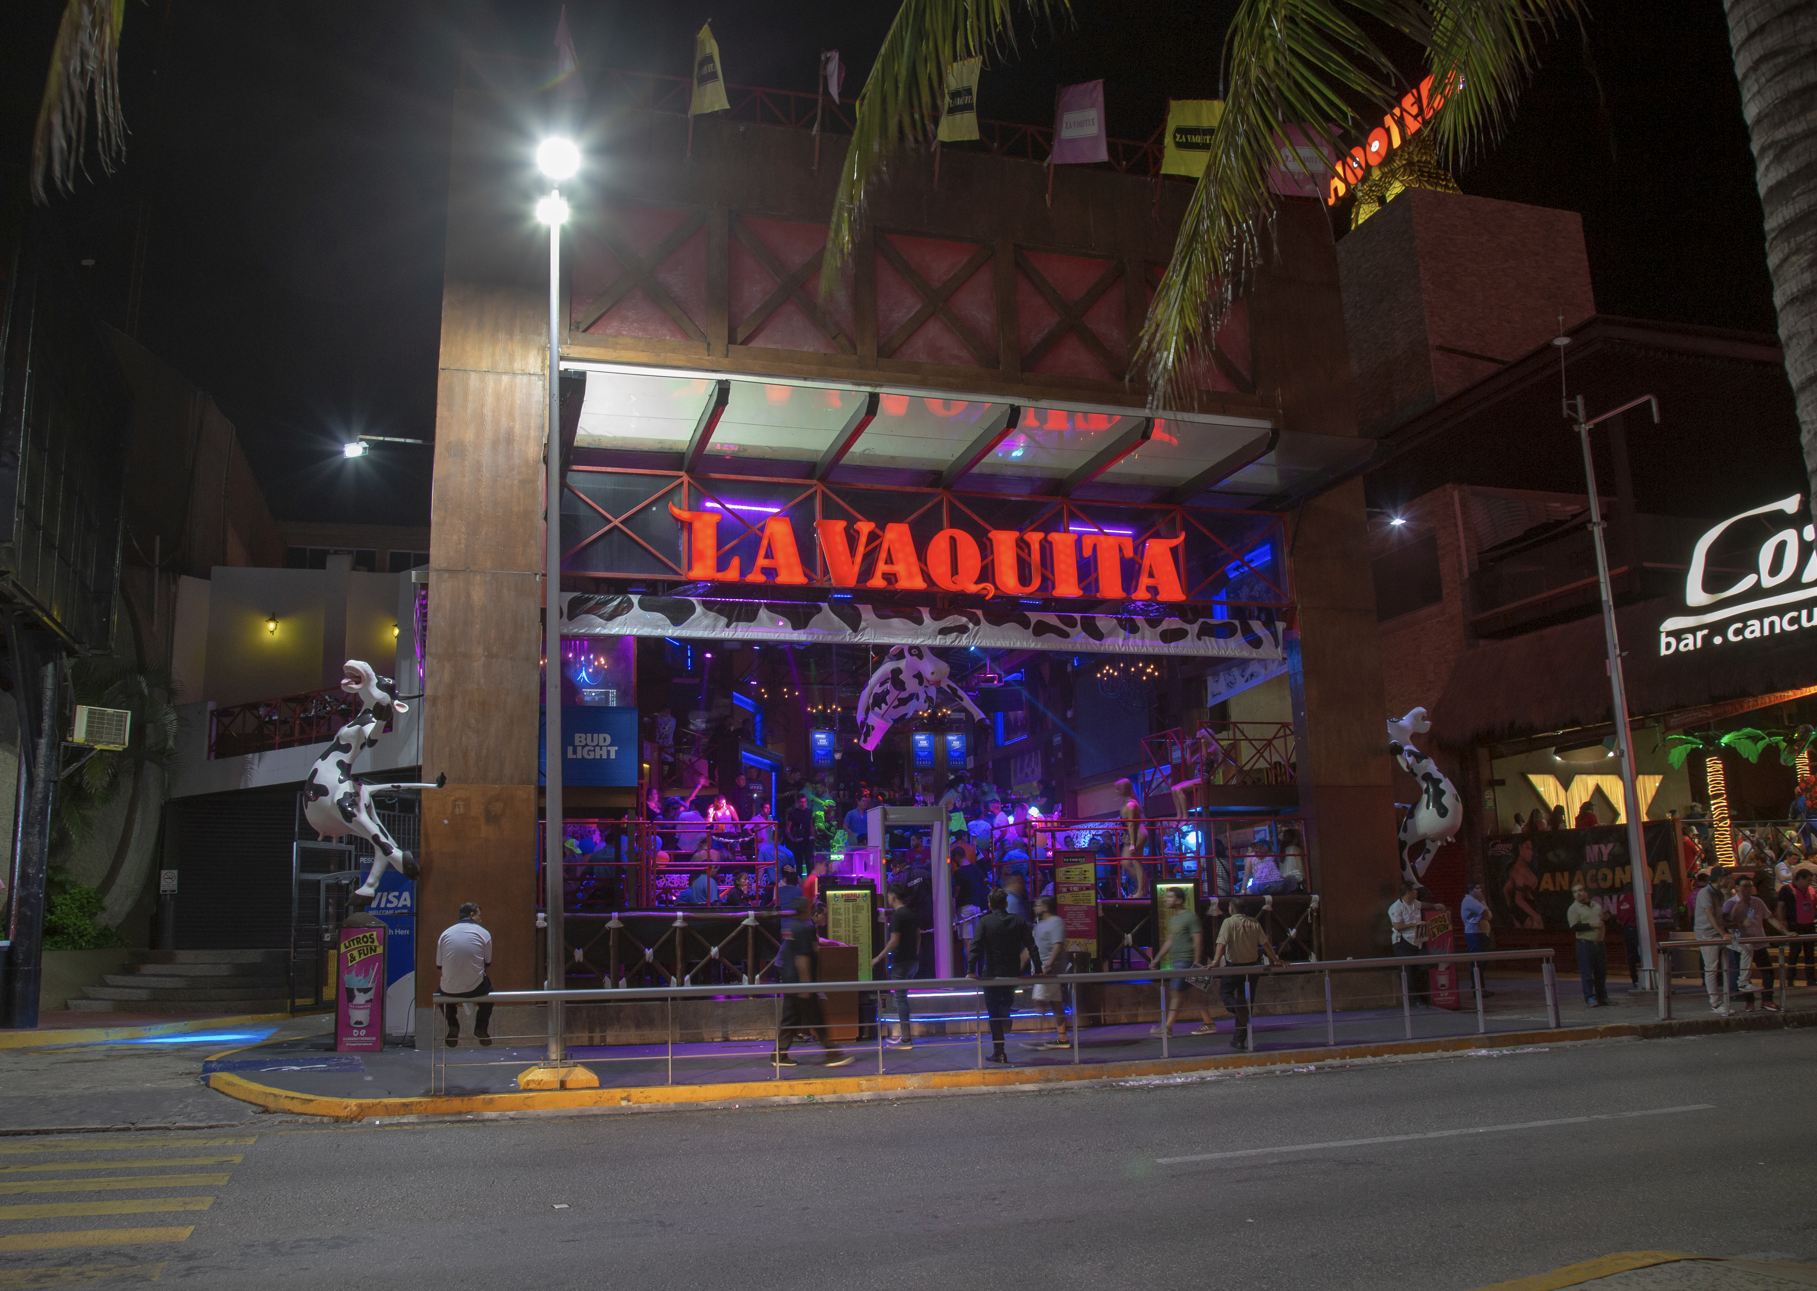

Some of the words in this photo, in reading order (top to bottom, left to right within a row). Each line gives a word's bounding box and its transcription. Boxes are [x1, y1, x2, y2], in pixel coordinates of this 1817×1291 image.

[574, 733, 611, 746] BUD
[567, 746, 619, 759] LIGHT
[1585, 842, 1616, 865] MY
[1538, 859, 1673, 892] ANACONA
[370, 891, 411, 908] VISA
[343, 933, 375, 949] LITROS
[349, 953, 357, 963] &
[358, 945, 378, 959] FUN
